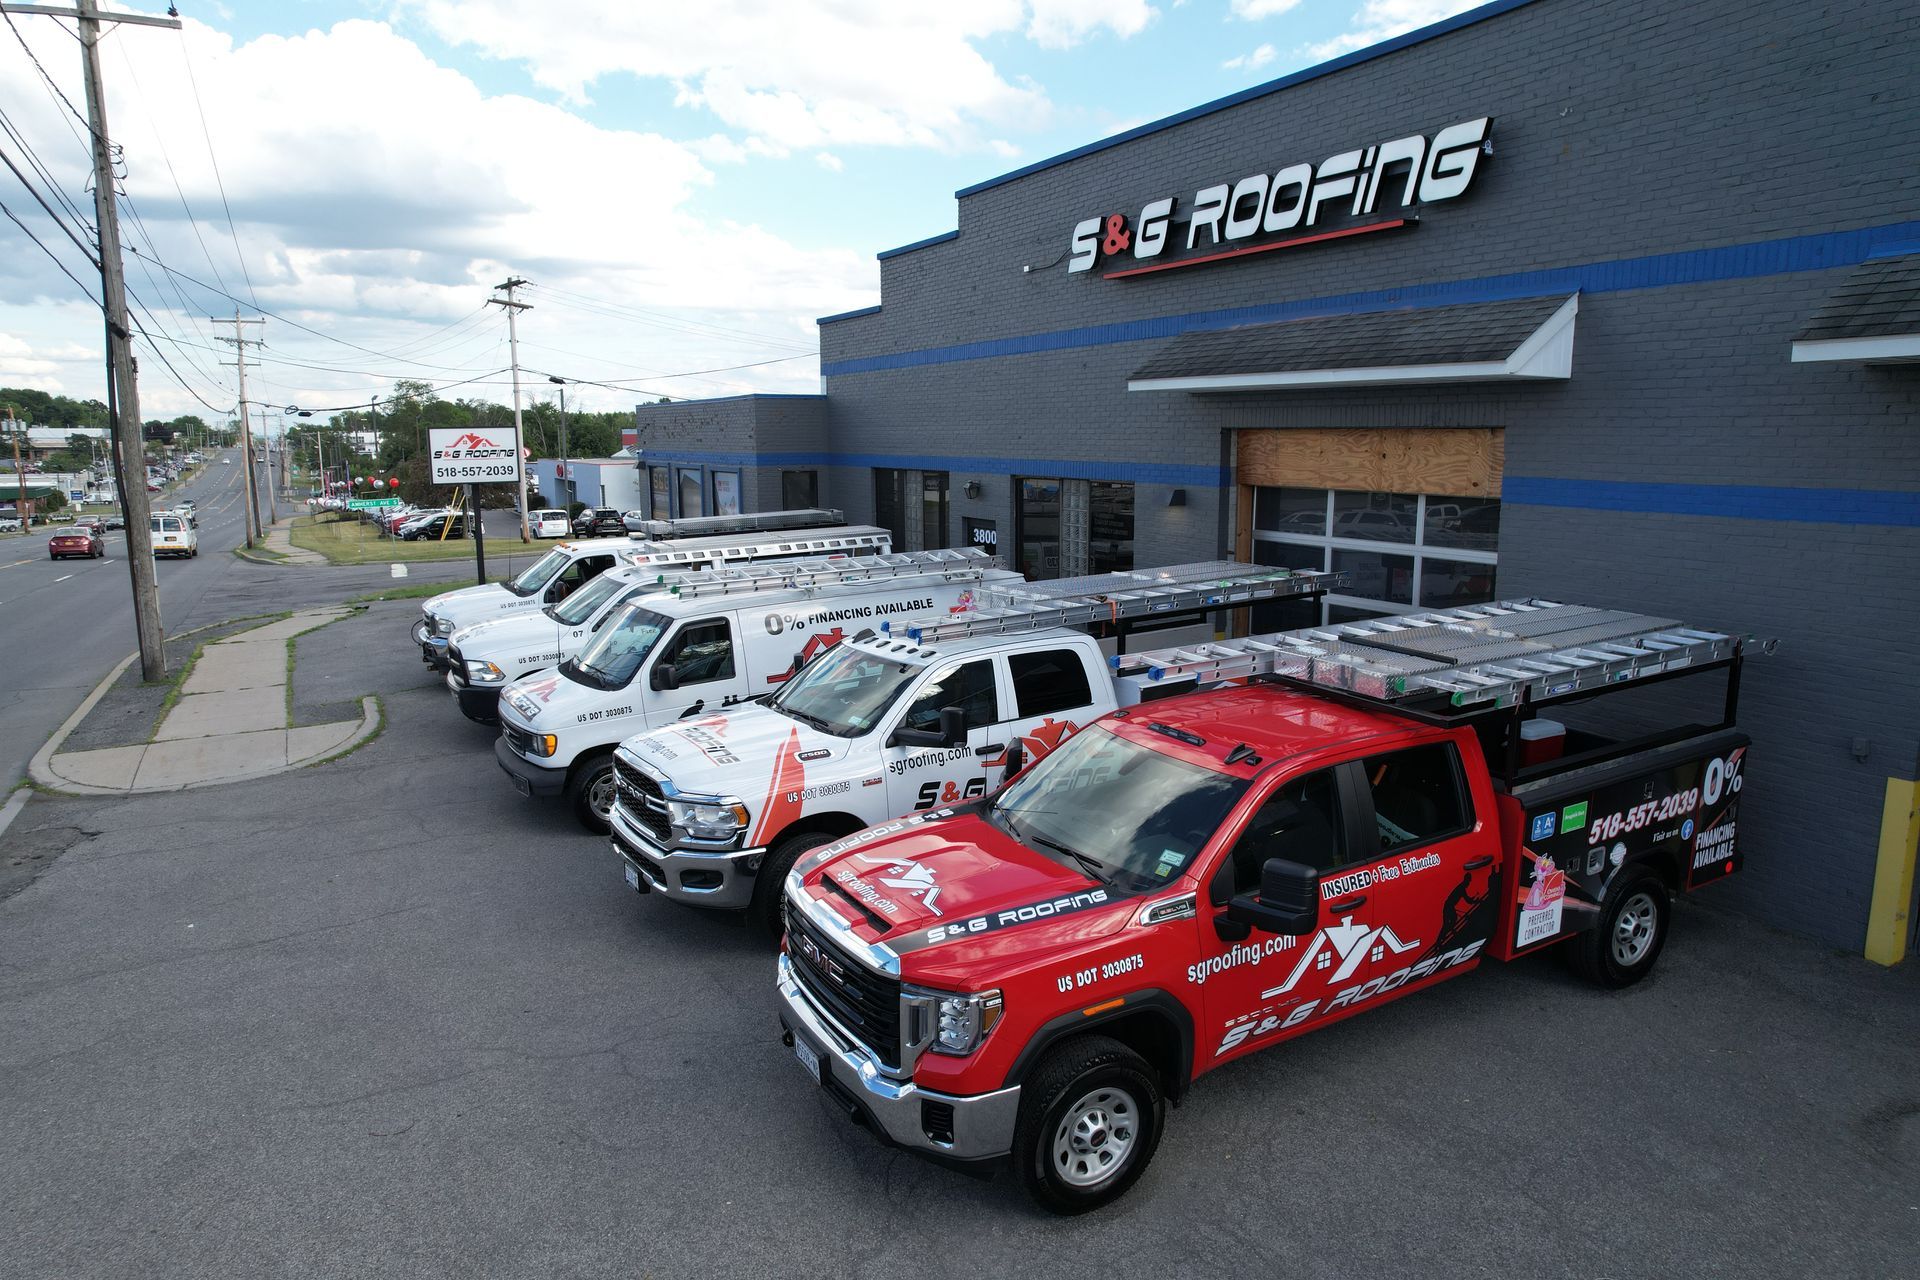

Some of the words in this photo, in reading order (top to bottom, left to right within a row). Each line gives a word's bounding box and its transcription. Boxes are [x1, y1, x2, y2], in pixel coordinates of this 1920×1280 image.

[1067, 197, 1178, 274] S&G
[433, 449, 461, 459] S&G
[437, 465, 514, 478] 518-557-2039
[973, 528, 997, 545] 3800
[764, 612, 805, 636] 0%
[808, 606, 872, 625] FINANCING
[875, 598, 934, 615] AVAILABLE
[573, 630, 584, 638] 07
[528, 655, 540, 663] DOT
[577, 713, 587, 723] US
[589, 711, 603, 720] DOT
[606, 705, 633, 718] 3030875
[889, 744, 972, 776] sgroofing.com
[787, 792, 799, 803] US
[801, 788, 817, 801] DOT
[819, 781, 850, 796] 3030875
[914, 777, 986, 810] S&G
[1703, 757, 1743, 806] 0%
[908, 808, 955, 825] S&G
[1588, 786, 1699, 845] 518-557-2039
[1695, 821, 1736, 850] FINANCING
[1693, 839, 1735, 870] AVAILABLE
[837, 869, 899, 914] sgroofing.com
[1321, 869, 1373, 900] INSURED
[1378, 864, 1399, 882] Free
[1399, 852, 1441, 875] Estimates
[927, 917, 988, 944] S&G
[1524, 920, 1555, 941] CONTRACTOR
[1528, 908, 1554, 928] PREFERRED
[801, 933, 844, 985] GMC
[1057, 974, 1073, 993] US
[1076, 968, 1098, 988] DOT
[1102, 954, 1144, 979] 3030875
[1187, 933, 1297, 984] sgroofing.com
[1214, 998, 1322, 1057] S&G
